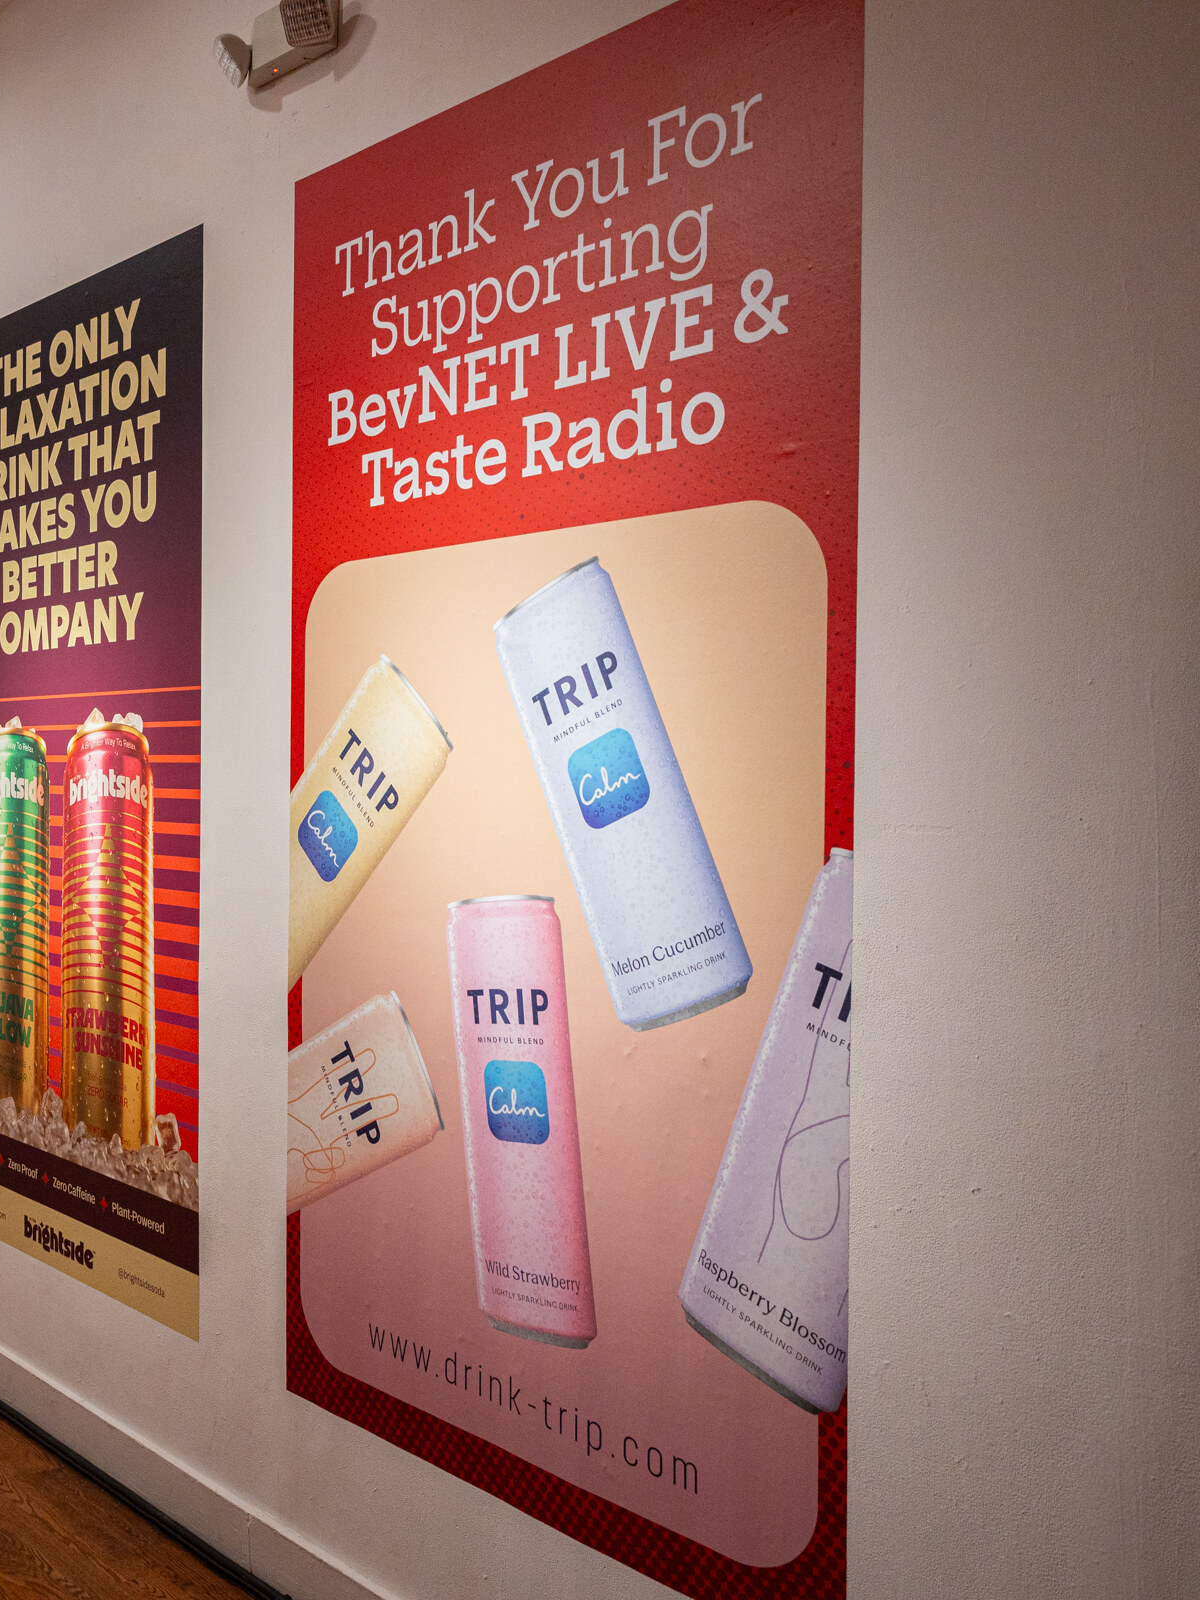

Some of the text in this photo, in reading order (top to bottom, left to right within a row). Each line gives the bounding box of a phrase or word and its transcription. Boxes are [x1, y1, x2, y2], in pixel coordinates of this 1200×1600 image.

[335, 92, 763, 297] Thank You For
[371, 203, 714, 357] Supporting
[48, 298, 141, 378] ONLY
[327, 268, 789, 446] BevNET LIVE &
[67, 409, 161, 482] THAT
[361, 377, 726, 507] Taste Radio
[81, 470, 157, 533] YOU
[2, 540, 119, 603] BETTER
[531, 650, 618, 726] TRIP
[553, 698, 624, 744] MINDFUL BLEND
[69, 768, 148, 809] brightside
[331, 766, 375, 828] MINDFUL BLEND
[339, 728, 400, 812] TRIP
[578, 766, 641, 806] Calm
[307, 809, 340, 868] Calm
[611, 921, 727, 978] Melon Cucumber
[626, 951, 728, 996] LIGHTLY SPARKLING DRINK
[466, 988, 549, 1025] TRIP
[74, 1031, 143, 1071] SUNSHINE
[477, 1036, 544, 1046] MINDFUL BLEND
[320, 1065, 352, 1148] MINDFUL BLEND
[330, 1040, 381, 1145] TRIP
[489, 1086, 546, 1118] Calm
[7, 1157, 38, 1180] Zero Proof
[52, 1176, 96, 1205] Zero Caffeine
[24, 1215, 94, 1269] brightside
[111, 1202, 165, 1235] Plant-Powered
[117, 1268, 166, 1298] @brightsidesoda
[484, 1258, 581, 1295] Wild Strawberry
[491, 1286, 579, 1313] LIGHTLY SPARKLING DRINK
[697, 1249, 847, 1364] Raspberry Blossom
[703, 1285, 824, 1376] LIGHTLY SPARKLING DRINK
[368, 1322, 699, 1495] www.drink-trip.com
